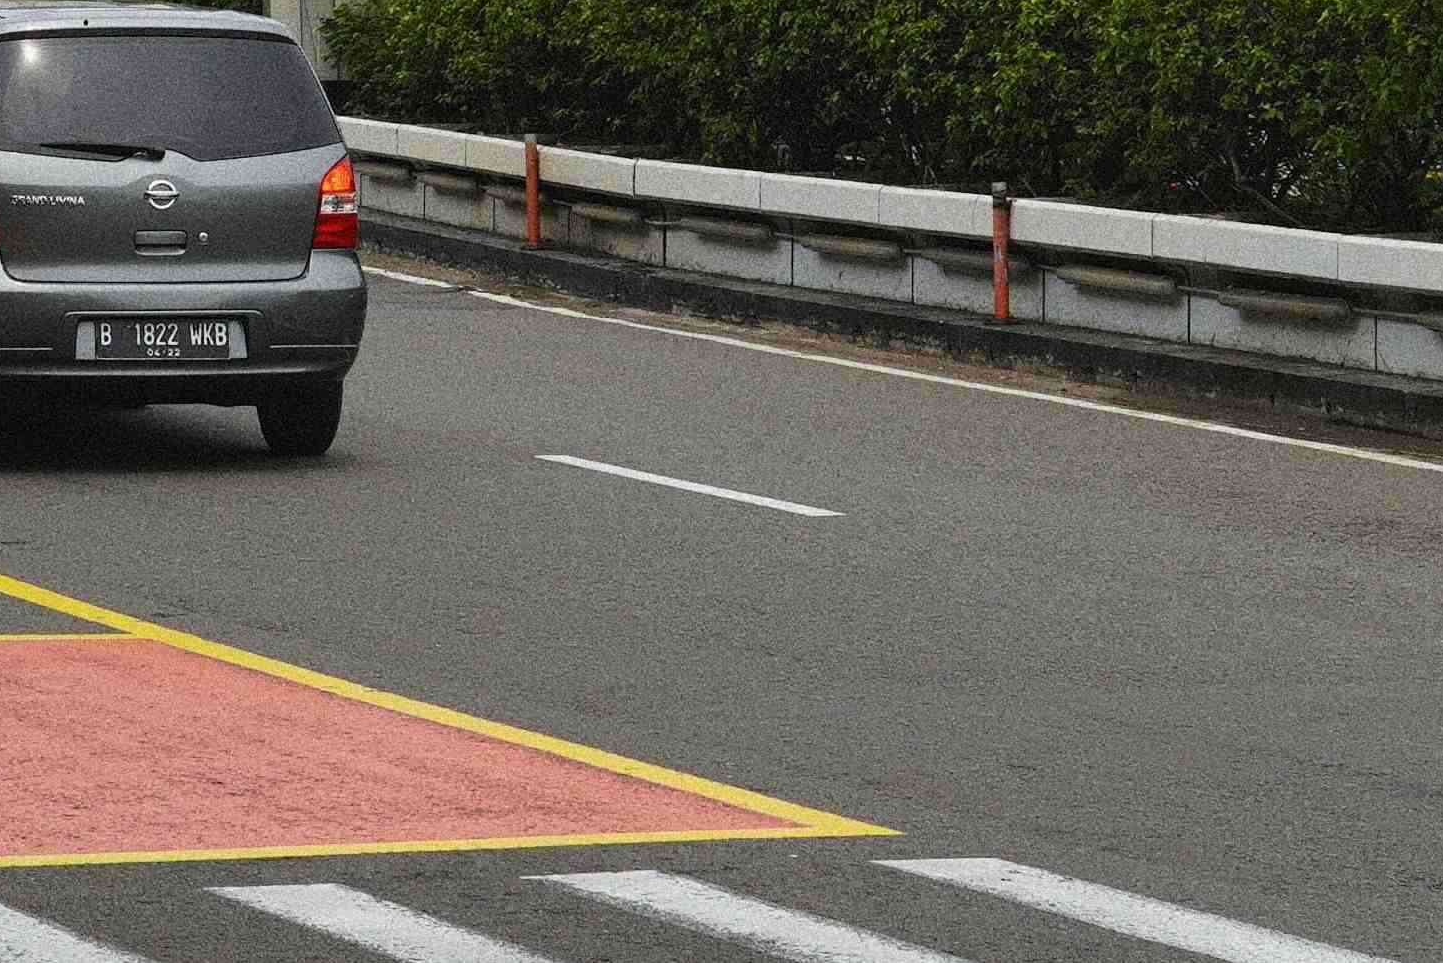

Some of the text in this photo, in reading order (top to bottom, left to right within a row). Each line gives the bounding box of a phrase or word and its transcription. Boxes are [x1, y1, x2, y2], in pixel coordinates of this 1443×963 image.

[99, 322, 228, 347] B 1822 WKB
